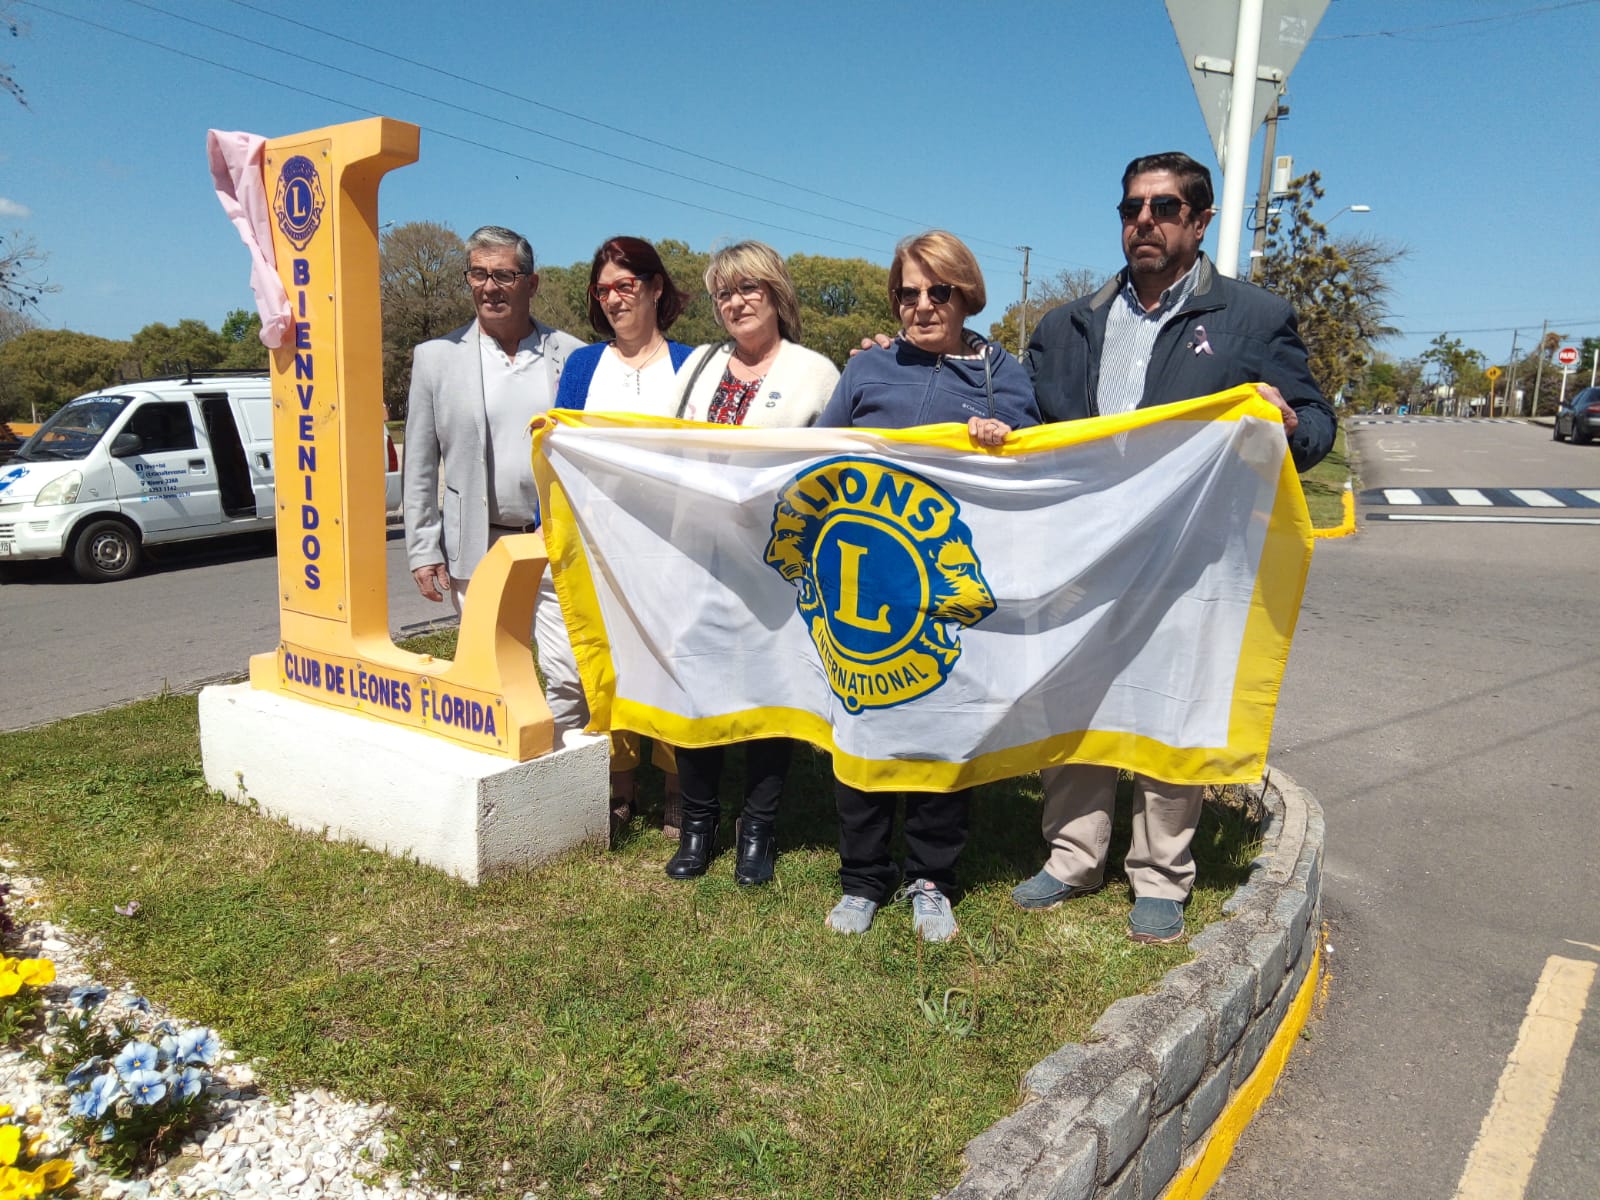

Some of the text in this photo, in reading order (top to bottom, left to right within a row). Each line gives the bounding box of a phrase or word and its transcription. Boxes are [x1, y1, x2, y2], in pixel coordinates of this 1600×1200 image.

[292, 186, 306, 217] L
[293, 258, 321, 590] BIENVENIDOS
[799, 468, 943, 532] LIONS
[833, 539, 892, 633] L
[284, 652, 497, 737] CLUB DE LEONES FLORIDA
[817, 630, 929, 696] INTERNATIONAL
